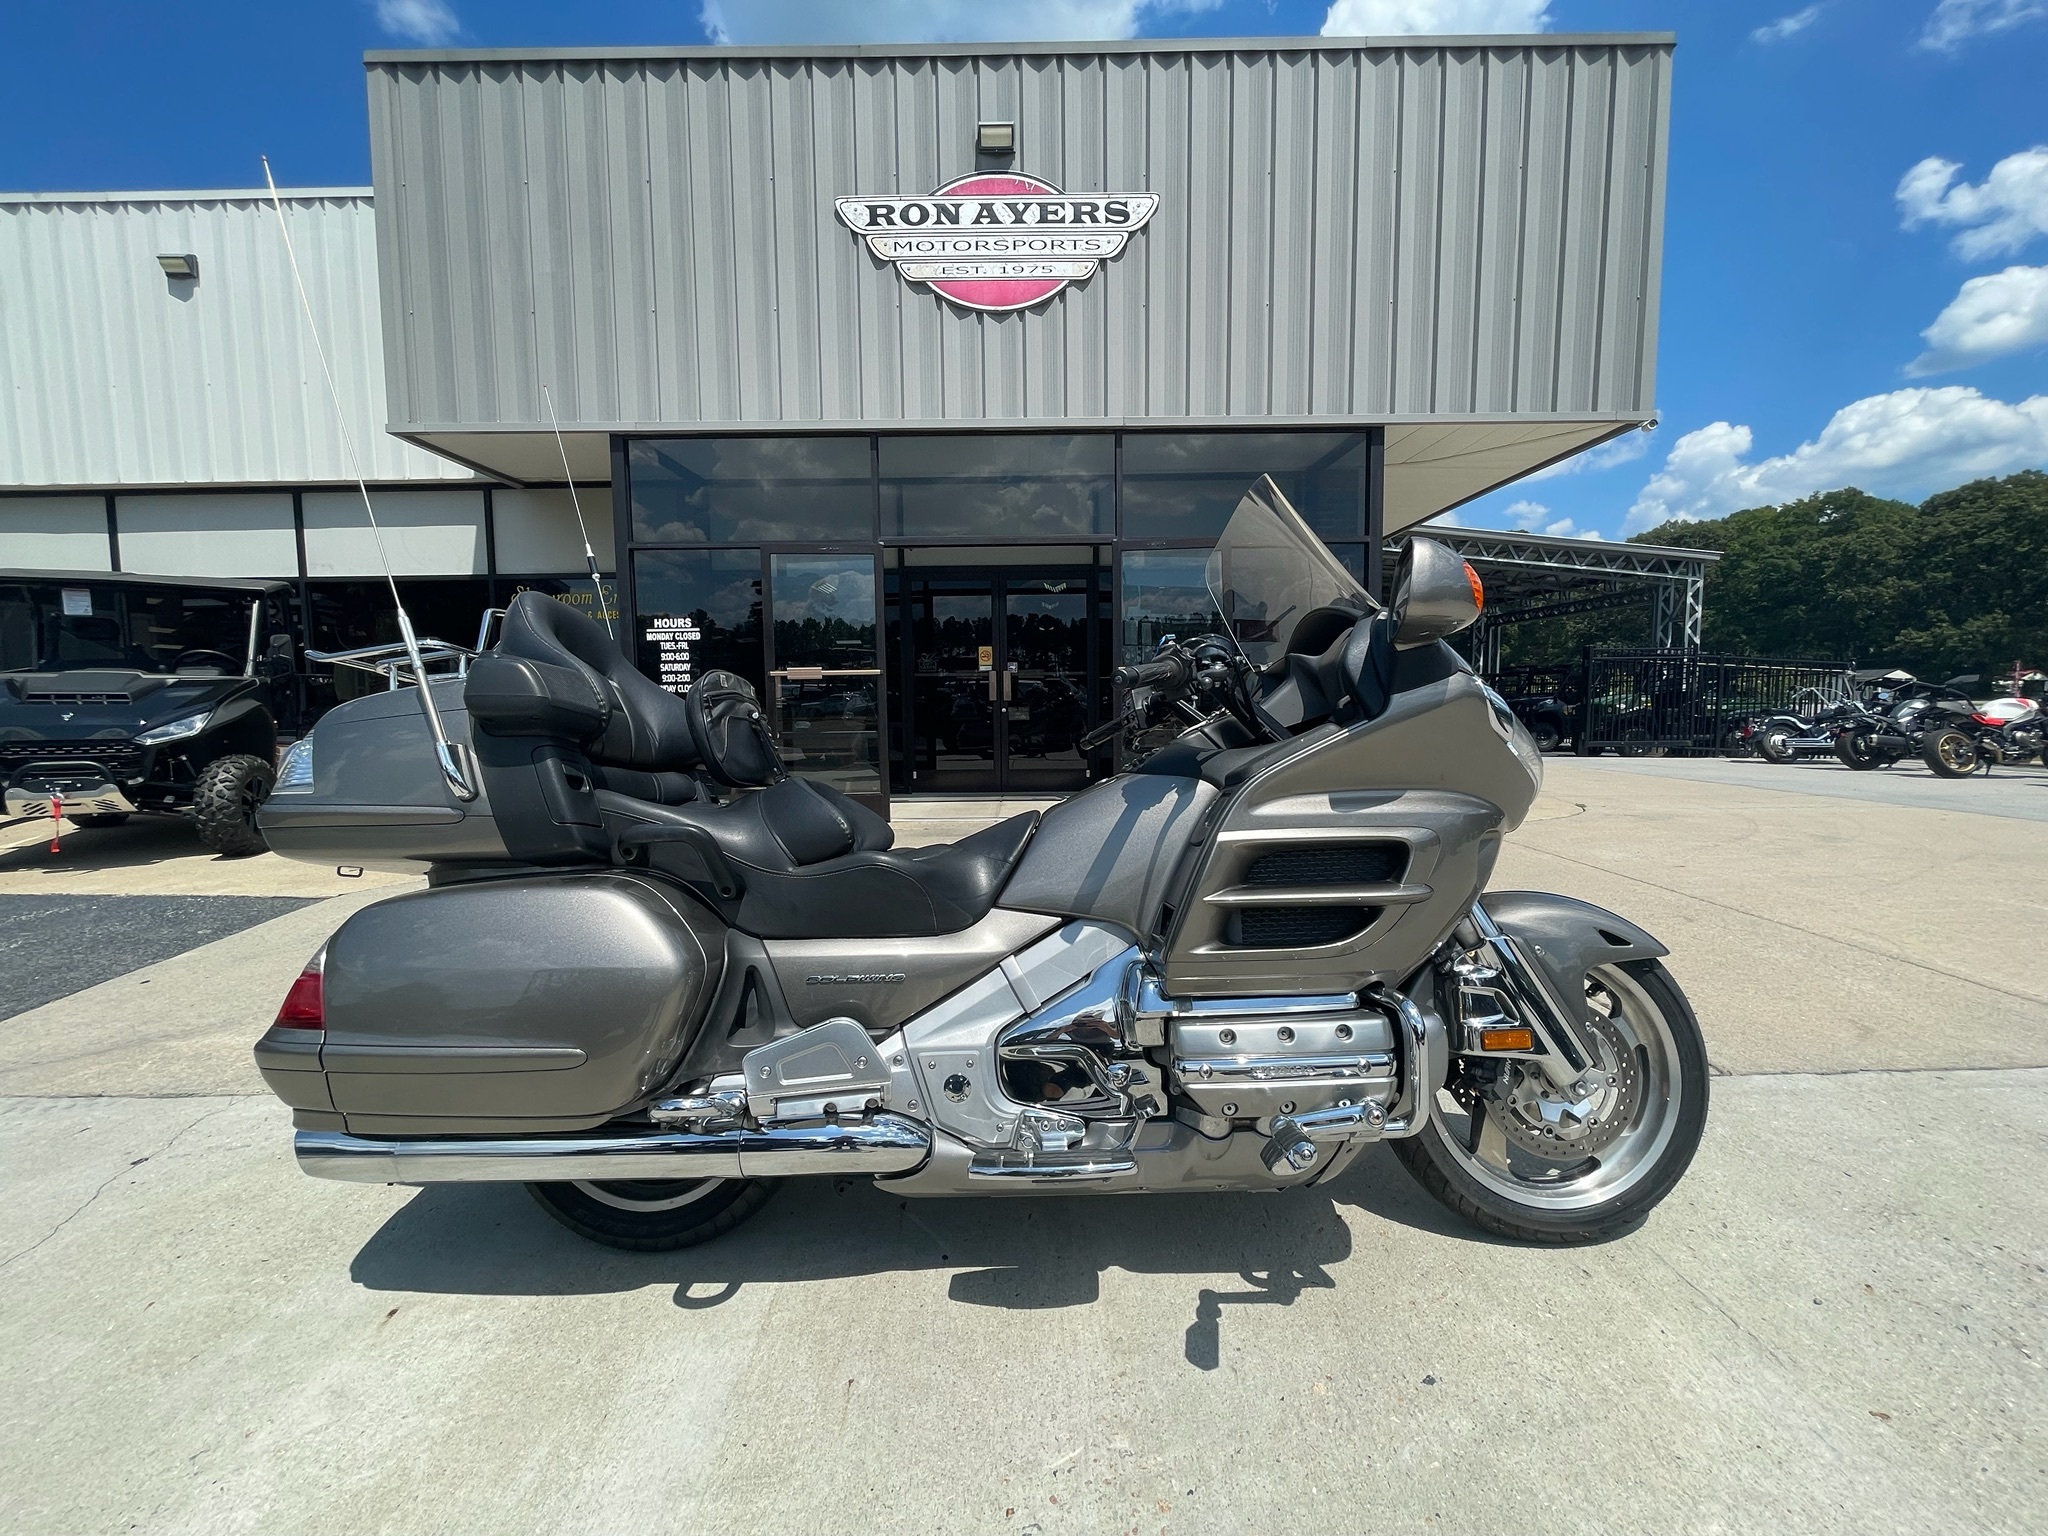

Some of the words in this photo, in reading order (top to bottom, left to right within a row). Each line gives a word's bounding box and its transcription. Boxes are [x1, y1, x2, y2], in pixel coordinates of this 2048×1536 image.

[864, 203, 964, 226] RON
[971, 200, 1131, 225] AYERS
[893, 239, 1101, 252] MOTORSPORTS
[942, 265, 987, 275] EST.
[999, 265, 1053, 275] 1975
[653, 618, 692, 628] HOURS
[646, 632, 674, 641] MONDAY
[674, 632, 701, 641] CLOSED
[660, 652, 690, 661] 9:00-6:00
[659, 662, 691, 672] SATURDAY
[661, 673, 691, 682] 9:00-2:00
